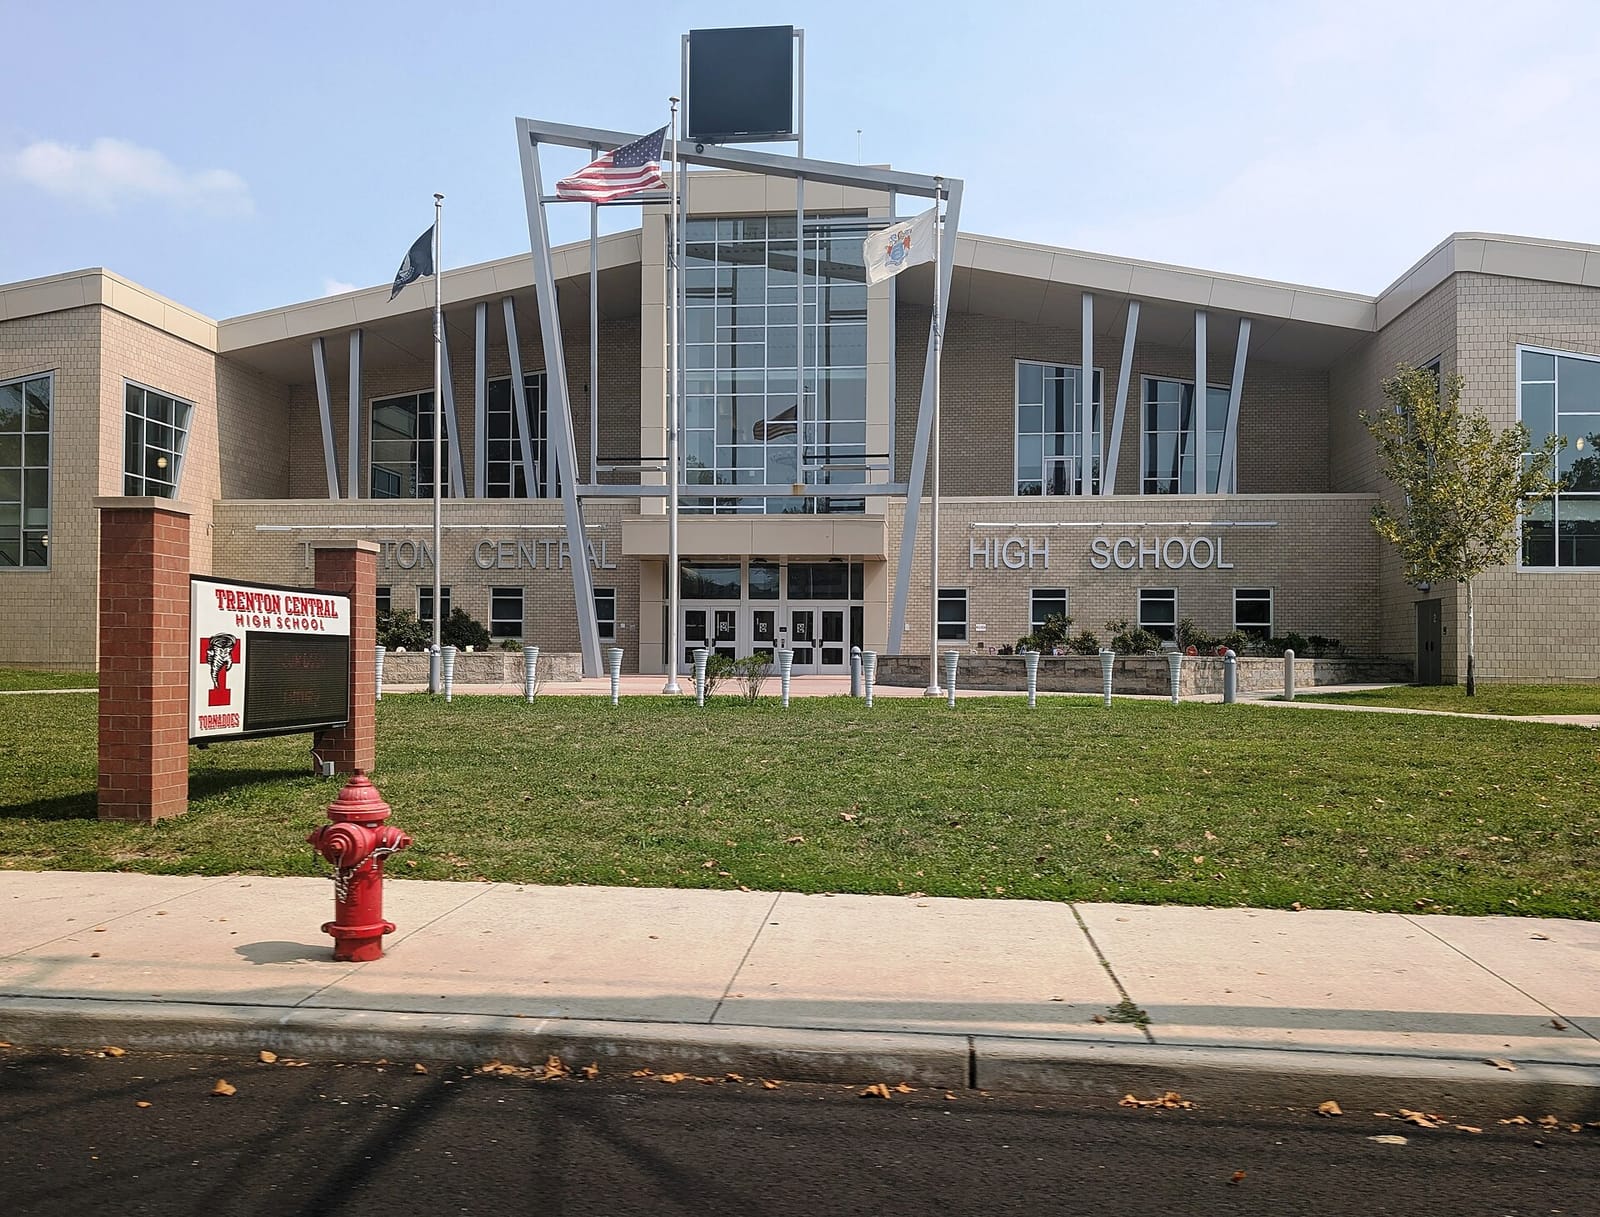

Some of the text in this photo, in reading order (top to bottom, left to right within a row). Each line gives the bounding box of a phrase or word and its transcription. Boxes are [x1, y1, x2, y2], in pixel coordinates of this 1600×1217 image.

[299, 538, 437, 569] TTON
[969, 536, 1234, 569] HIGH SCHOOL
[215, 588, 339, 618] TRENTON CENTRAL
[235, 613, 325, 631] HIGH SCHOOL
[198, 712, 241, 730] TORNADOES
